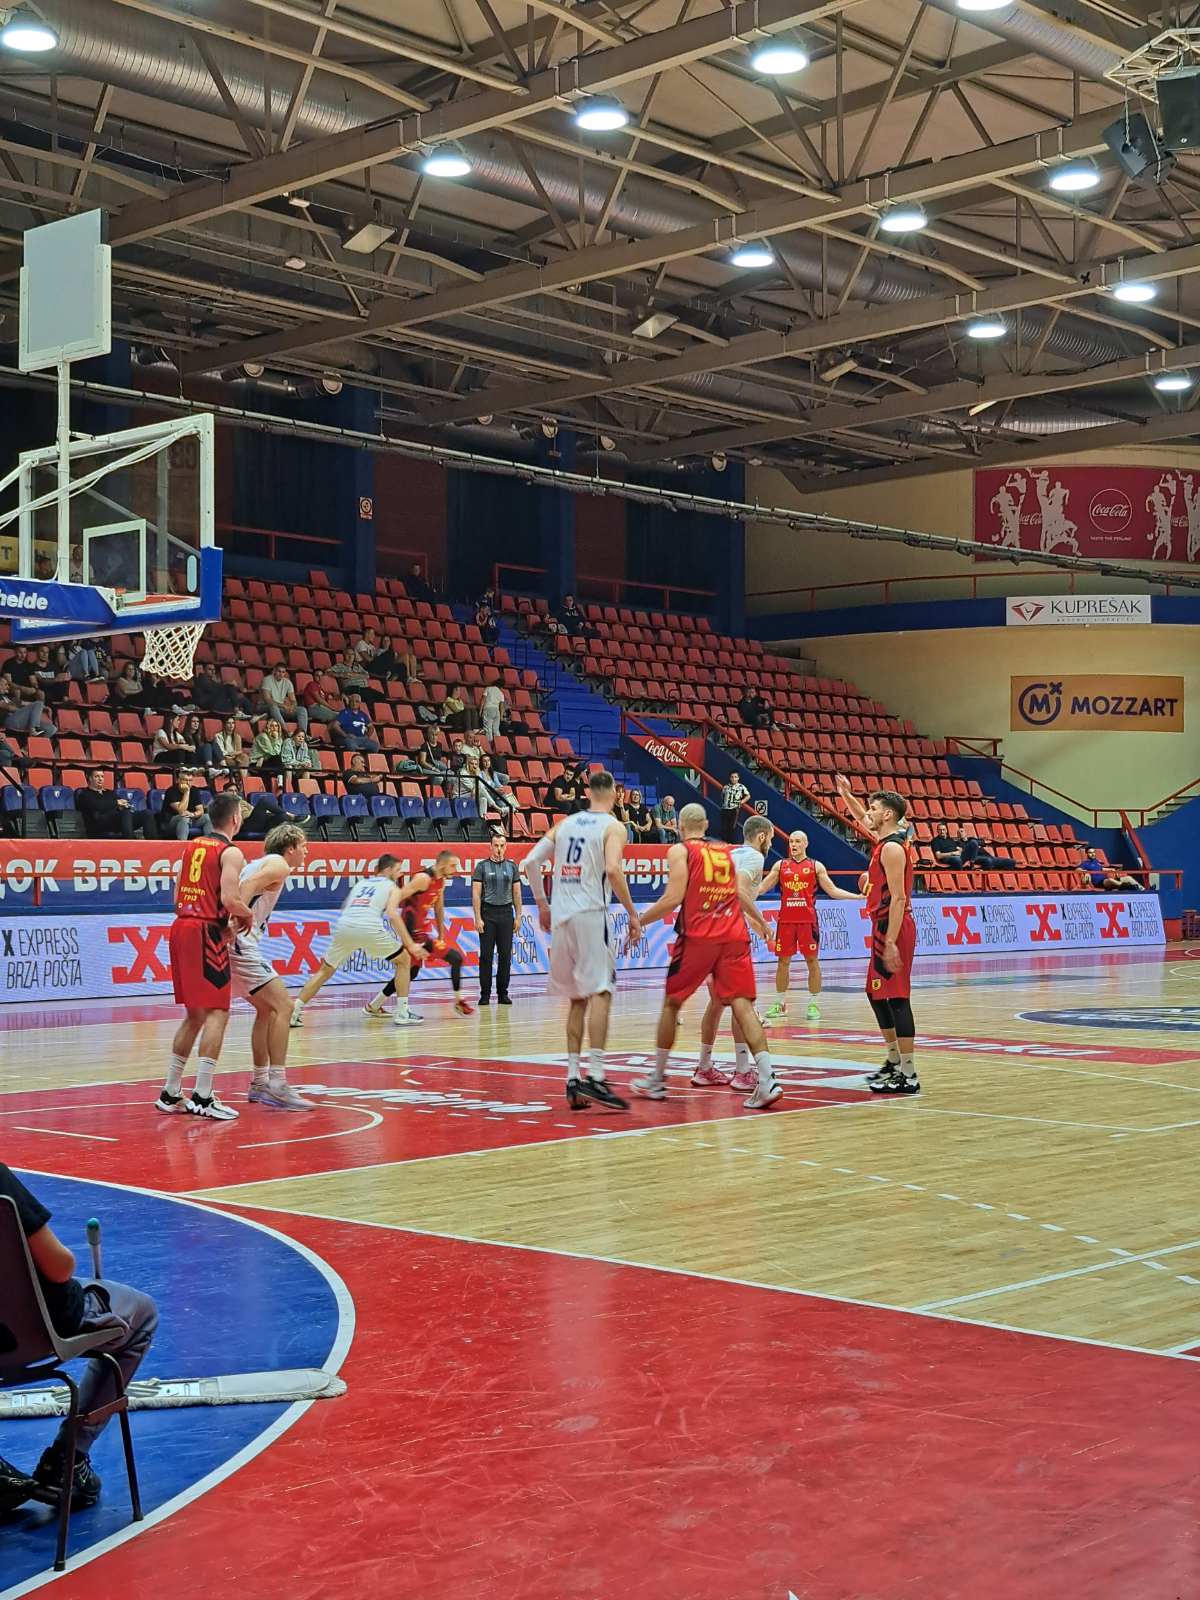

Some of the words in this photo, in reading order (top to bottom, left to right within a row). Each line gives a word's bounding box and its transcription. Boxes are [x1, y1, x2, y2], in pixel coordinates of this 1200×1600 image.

[1051, 597, 1142, 614] KUPREŠAK
[1070, 696, 1178, 716] MOZZART
[566, 836, 585, 864] 16
[73, 859, 183, 895] ВРБА
[189, 847, 207, 883] 8
[700, 847, 731, 884] 15
[356, 886, 377, 898] 34
[981, 905, 988, 922] X
[987, 903, 1015, 922] EXPRESS
[1067, 902, 1092, 921] EXPRESS
[1, 929, 15, 957] X
[18, 927, 79, 957] EXPRESS
[6, 961, 39, 990] BRZA
[43, 954, 83, 988] POŠTA
